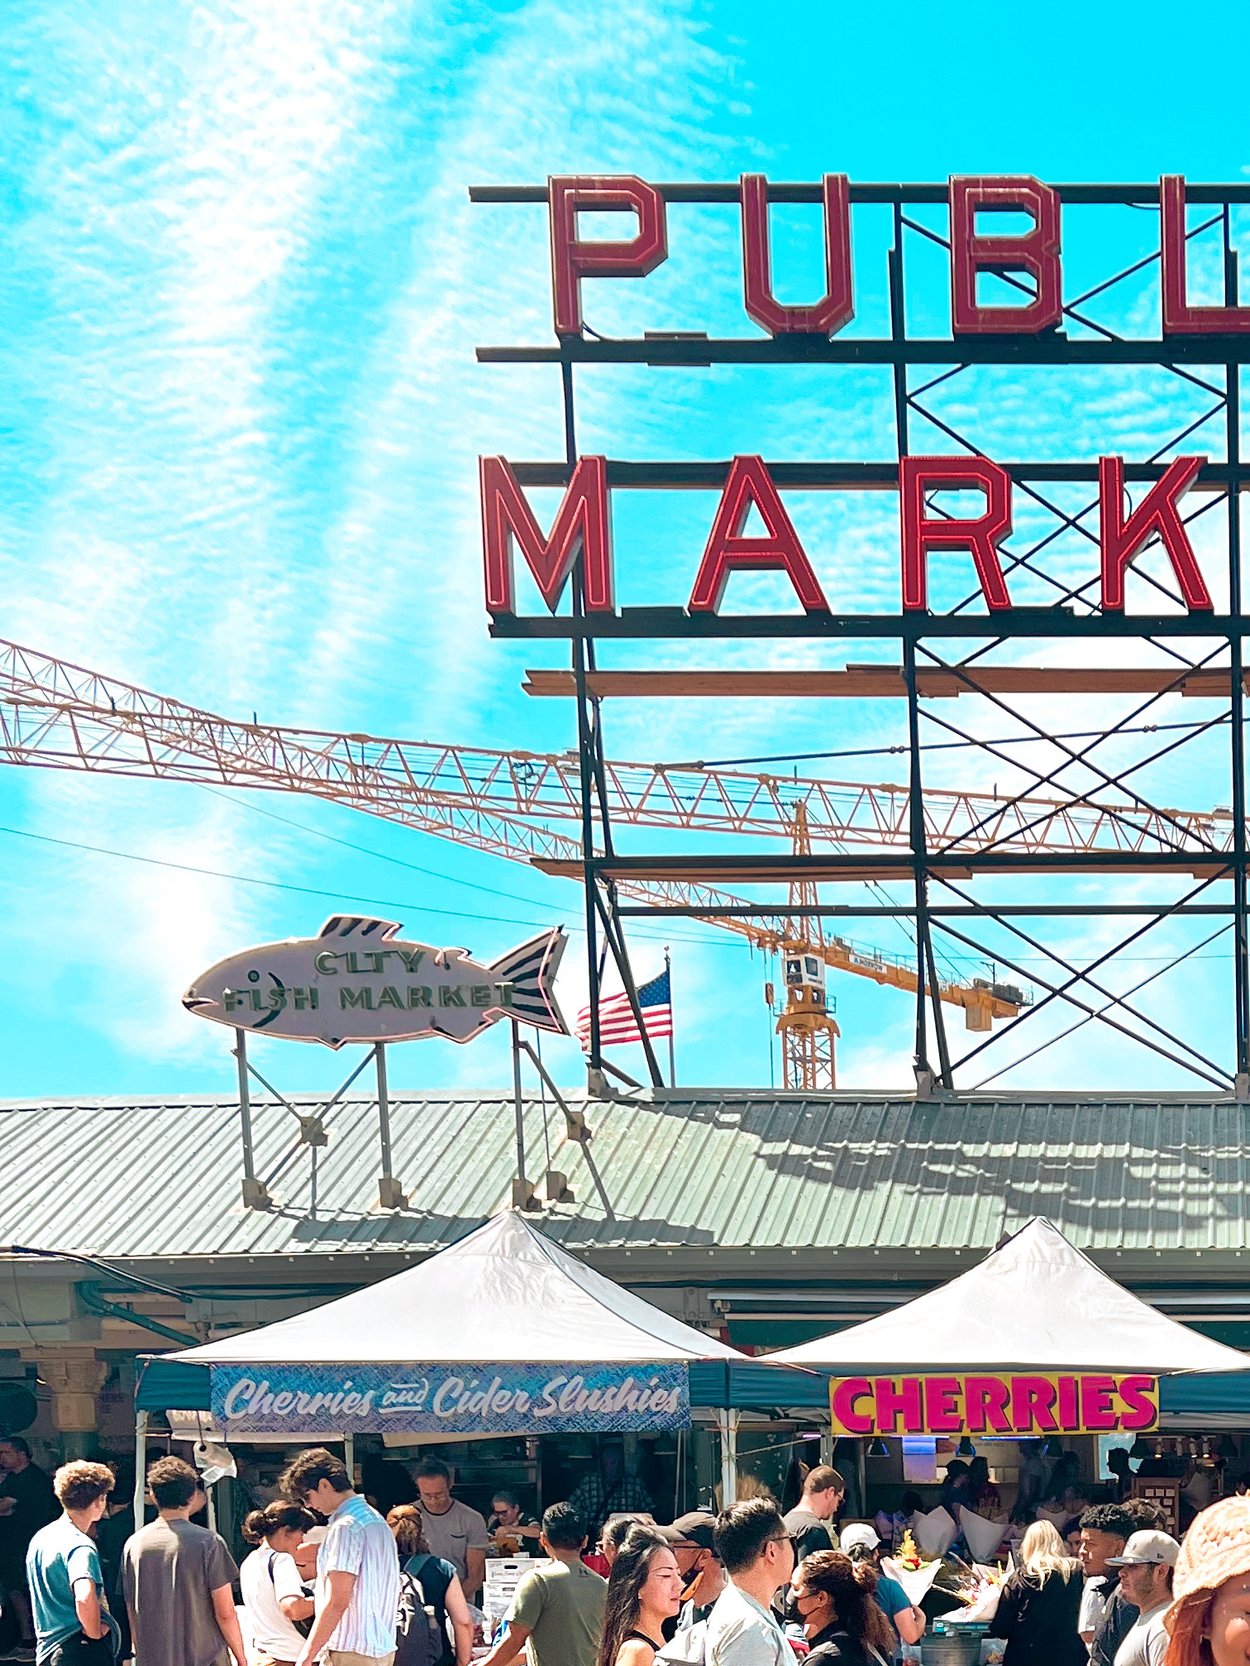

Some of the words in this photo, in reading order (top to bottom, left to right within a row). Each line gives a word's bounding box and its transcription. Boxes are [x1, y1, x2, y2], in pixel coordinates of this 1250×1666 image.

[314, 948, 427, 976] CITY
[221, 985, 320, 1013] FISH
[337, 981, 519, 1011] MARKET
[224, 1377, 376, 1420] Cherries
[381, 1377, 429, 1412] and
[432, 1374, 538, 1418] Cider
[533, 1374, 681, 1418] Slushies
[831, 1375, 1158, 1433] CHERRIES
